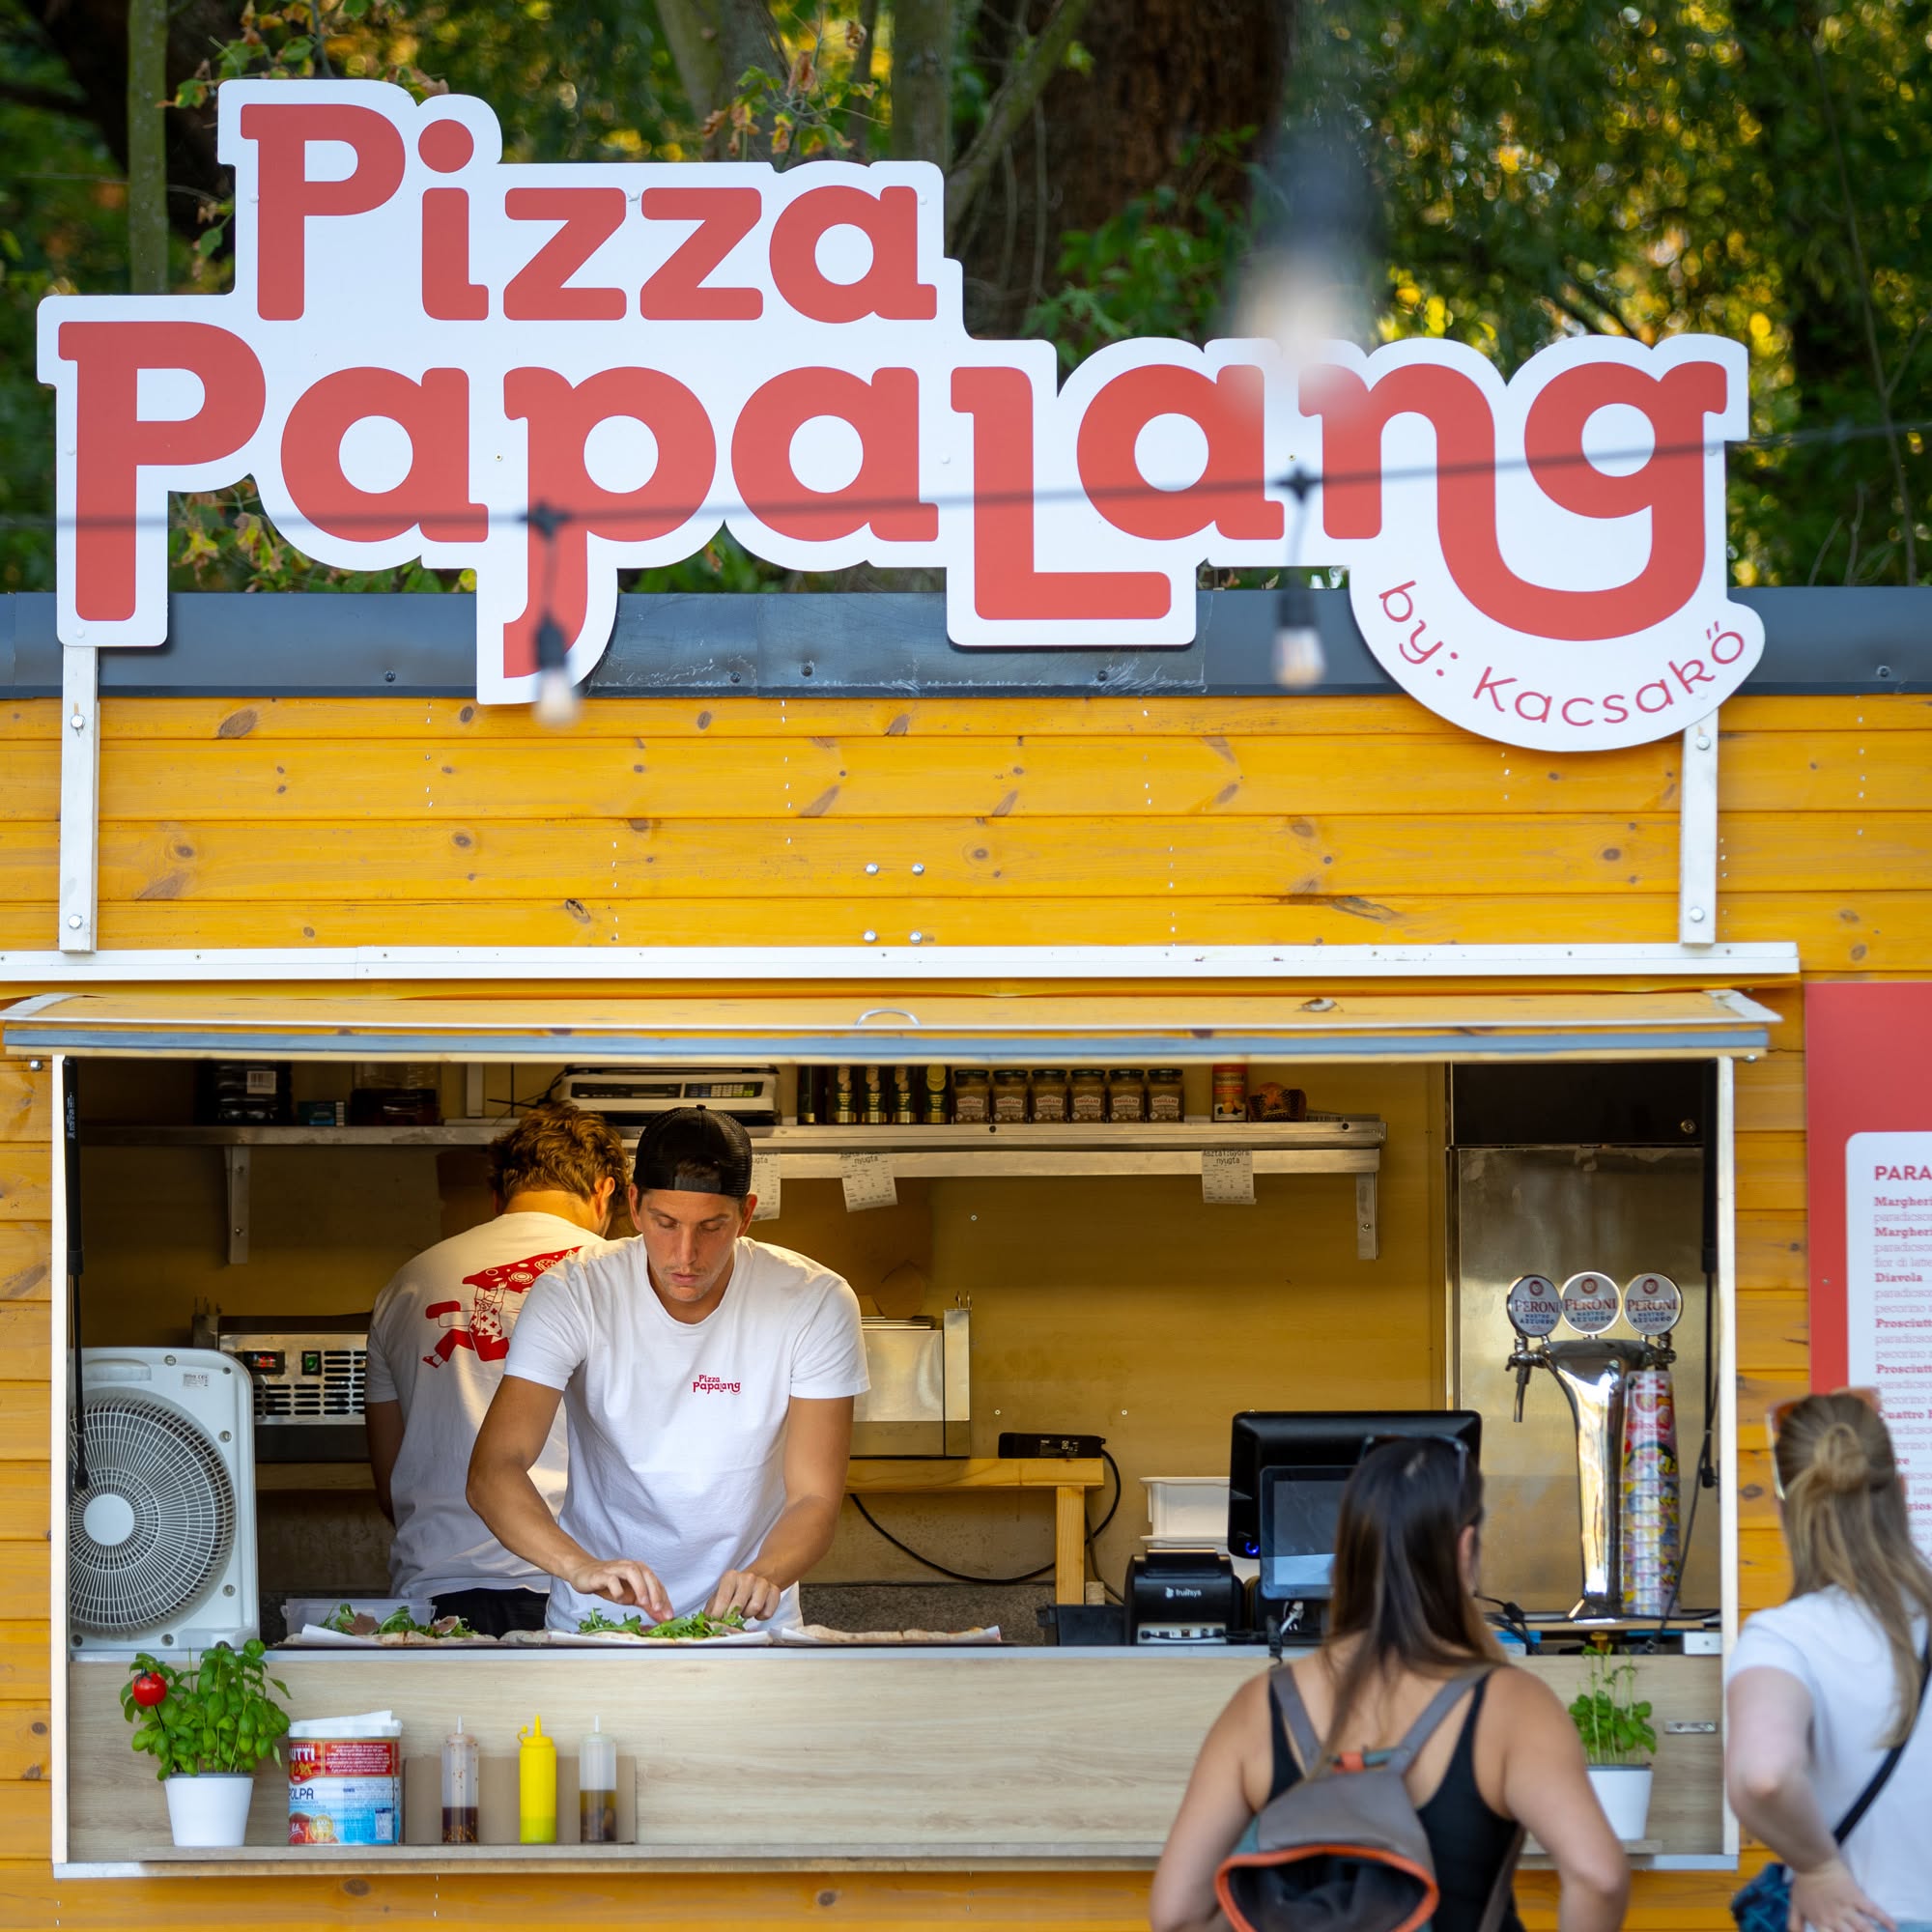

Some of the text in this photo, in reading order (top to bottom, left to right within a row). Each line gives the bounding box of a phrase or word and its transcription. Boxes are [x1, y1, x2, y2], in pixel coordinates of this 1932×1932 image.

[240, 103, 937, 324] Pizza
[1378, 580, 1459, 677] by:
[1875, 1272, 1922, 1283] Diavola
[1515, 1299, 1560, 1313] PERONI
[1565, 1298, 1616, 1312] PERONI
[1628, 1299, 1676, 1312] PERONI
[698, 1374, 721, 1382] Pizza
